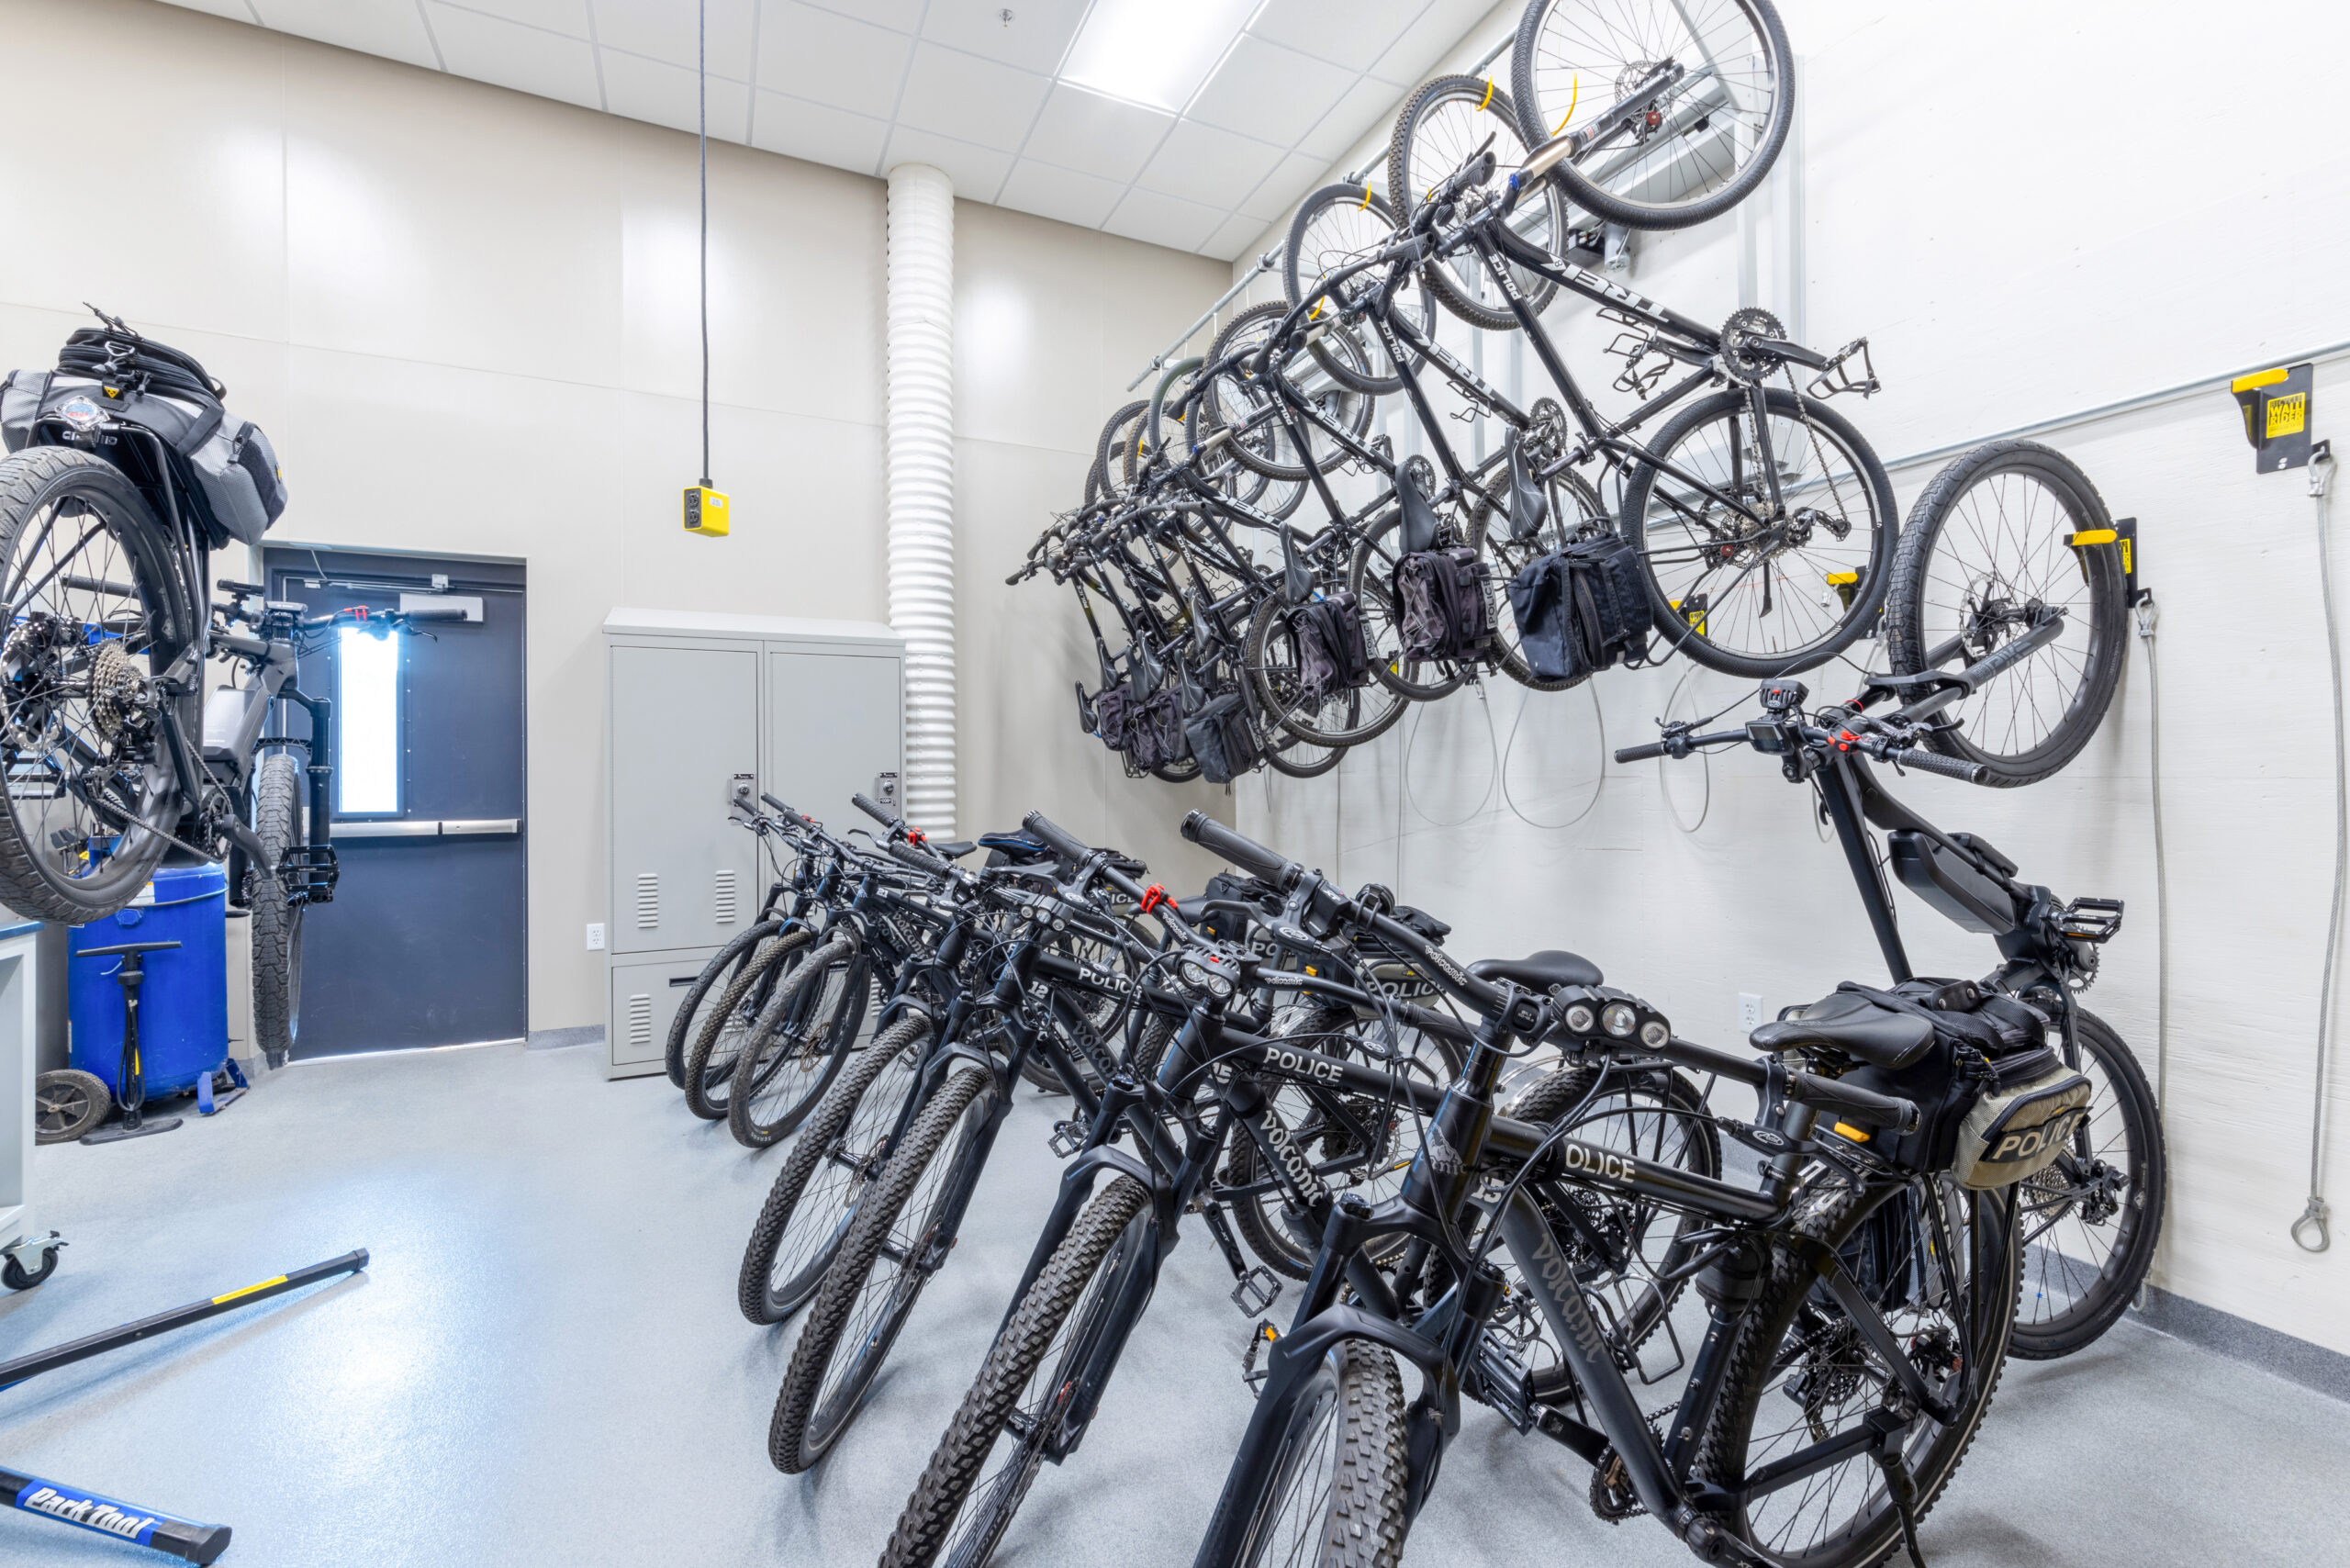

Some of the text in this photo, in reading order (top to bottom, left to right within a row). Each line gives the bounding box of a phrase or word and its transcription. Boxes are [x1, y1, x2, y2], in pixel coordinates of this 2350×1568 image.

[1489, 253, 1522, 300] POLICE
[1540, 253, 1669, 322] TREK
[1379, 317, 1404, 363] POLICE
[1414, 331, 1495, 402] TREK
[1271, 390, 1294, 426] POLICE
[1303, 398, 1375, 458] TREK
[1362, 625, 1375, 656] POLIC
[892, 911, 927, 958] volcani
[1162, 912, 1189, 942] volcanic
[1265, 975, 1304, 986] volcanic
[1425, 945, 1468, 987] volcanic
[1027, 980, 1049, 1000] 12
[1263, 1047, 1344, 1083] POLICE
[1259, 1109, 1324, 1207] volcanic
[1565, 1143, 1636, 1183] OLICE
[1531, 1232, 1607, 1363] volcanic
